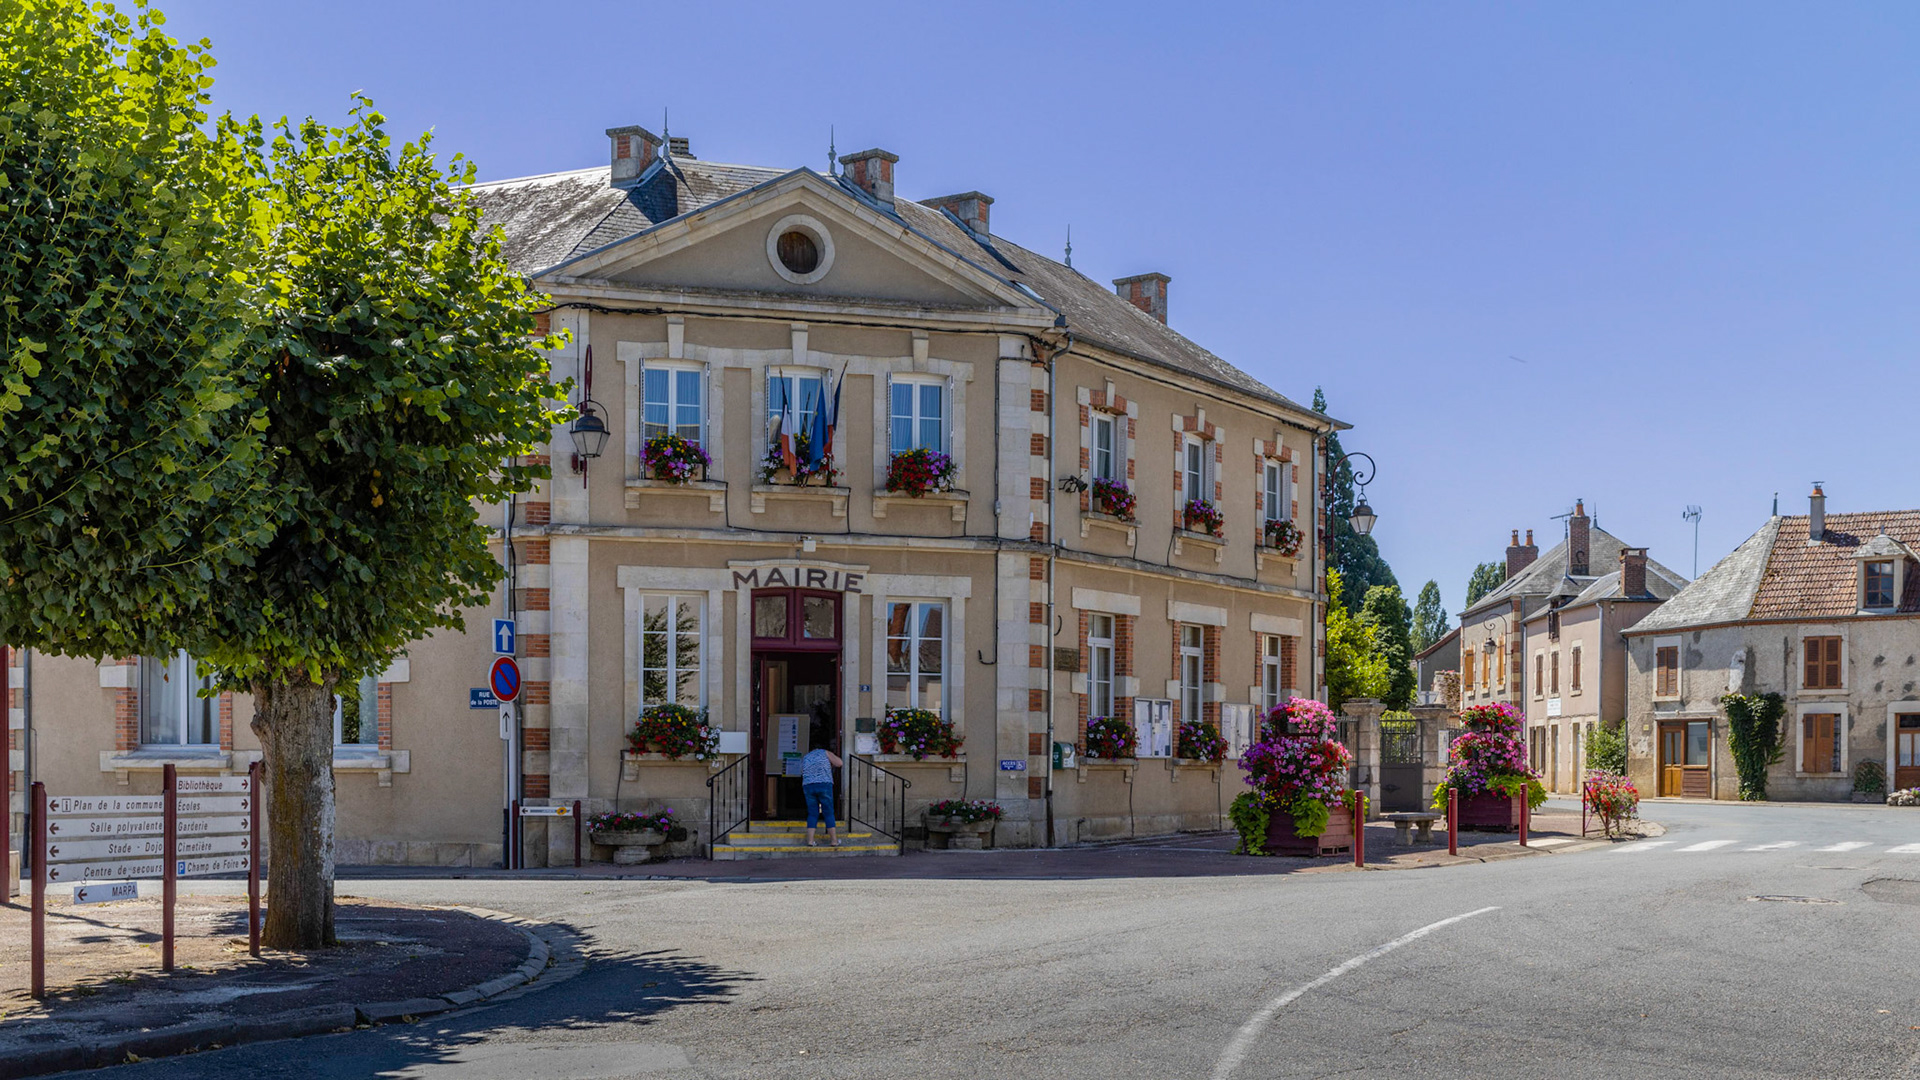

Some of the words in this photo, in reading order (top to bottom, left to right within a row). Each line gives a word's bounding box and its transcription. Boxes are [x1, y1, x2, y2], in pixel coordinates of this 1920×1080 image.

[732, 567, 864, 593] MAIRIE
[178, 780, 223, 792] Bibliothèque
[73, 800, 93, 811] Plan
[98, 800, 108, 810] de
[113, 800, 121, 810] la
[126, 800, 163, 810] commune
[177, 799, 201, 811] Écoles
[90, 822, 112, 833] Salle
[116, 821, 163, 834] polyvalente
[178, 821, 208, 832] Garderie
[108, 843, 132, 854] Stade
[145, 842, 163, 854] Dojo
[178, 842, 212, 853] Cimetière
[84, 866, 112, 878] Centre
[117, 865, 127, 876] de
[132, 863, 163, 875] secours
[187, 862, 209, 873] Champ
[212, 861, 220, 870] de
[223, 860, 239, 869] Foire
[112, 885, 136, 897] MARPA
